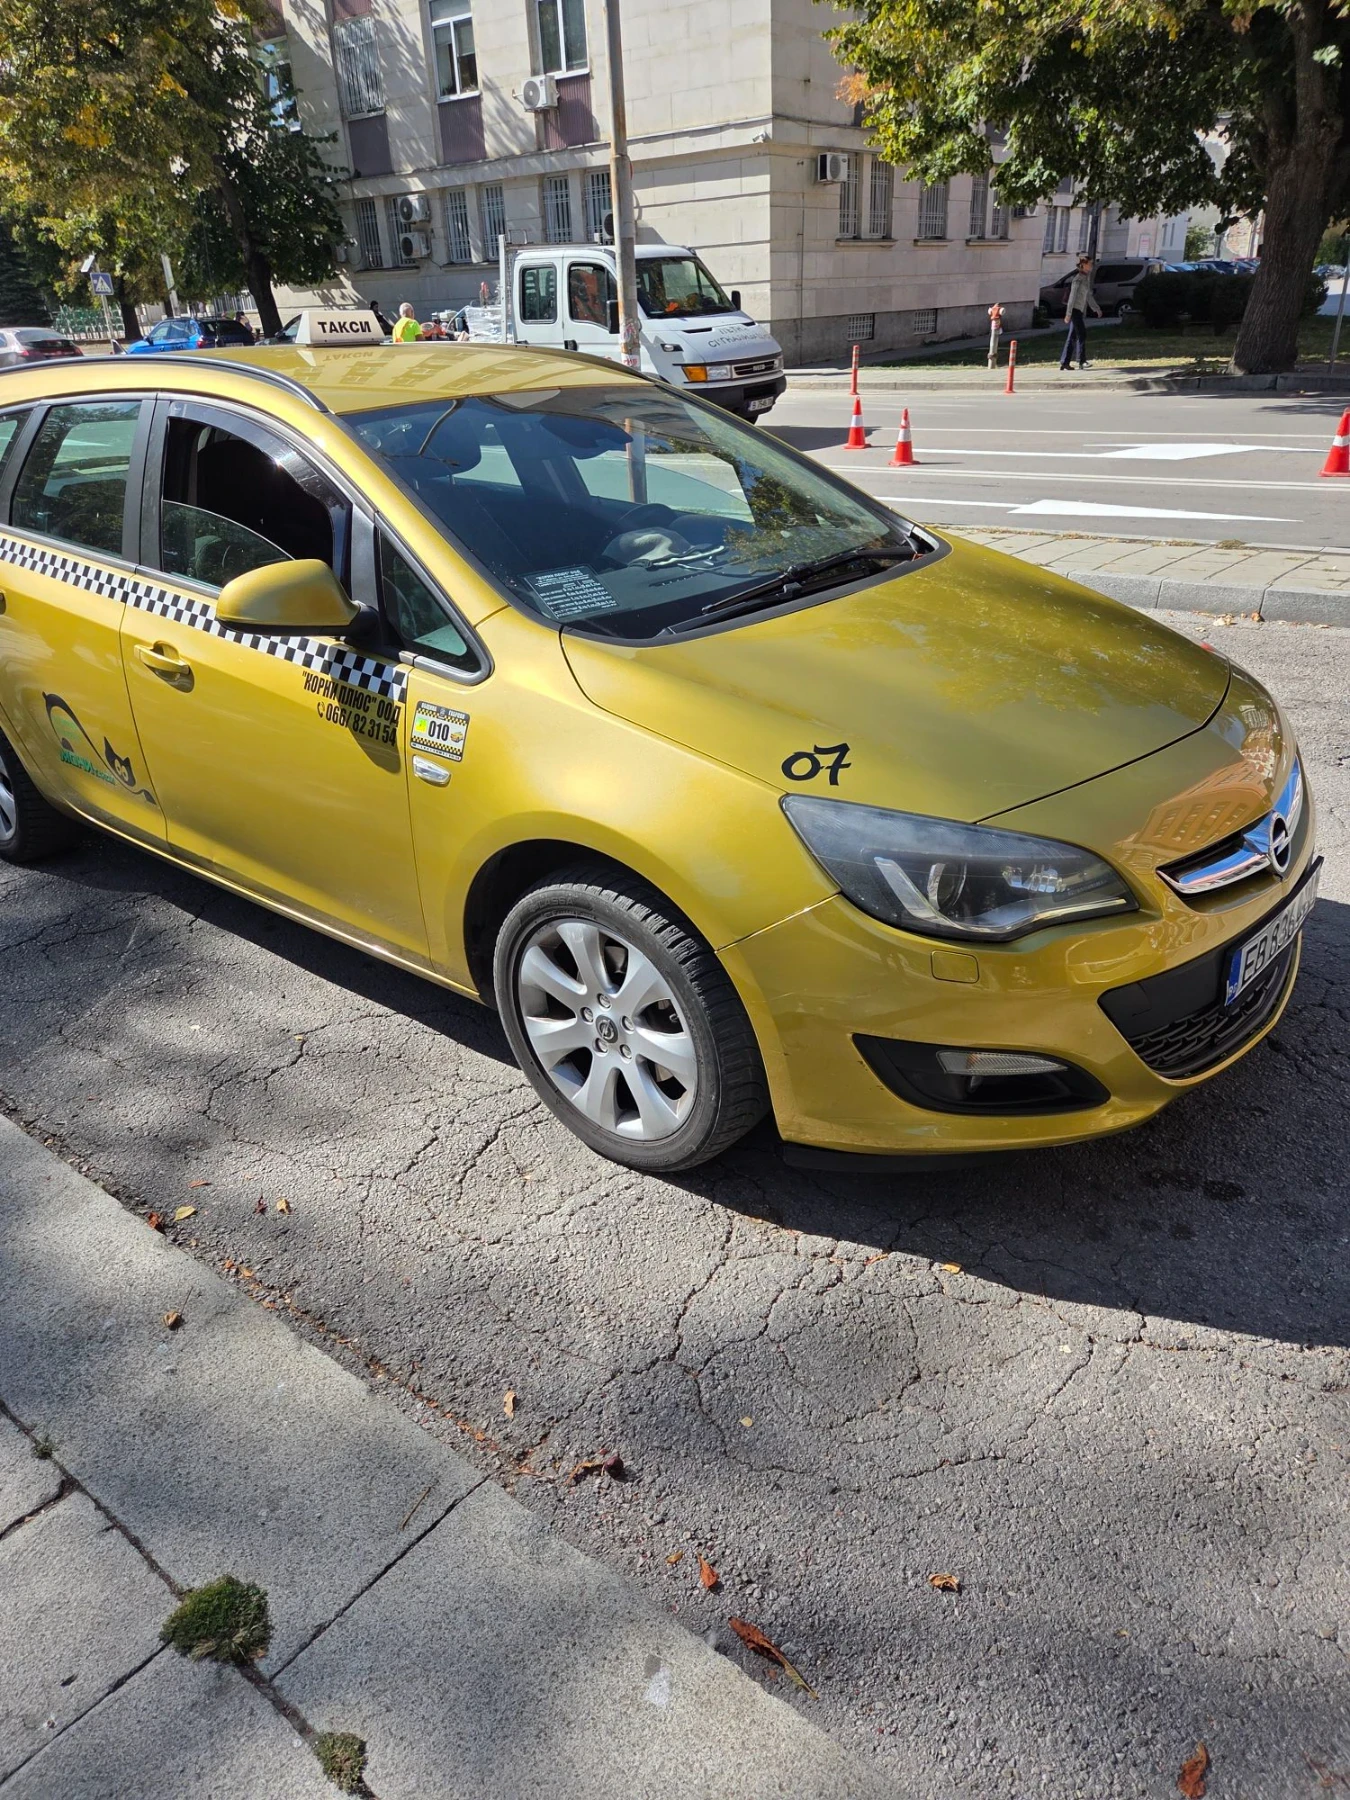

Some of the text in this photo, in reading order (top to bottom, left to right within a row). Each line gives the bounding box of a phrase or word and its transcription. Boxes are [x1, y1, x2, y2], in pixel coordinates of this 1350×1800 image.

[317, 321, 372, 334] ТАКСИ
[302, 671, 402, 728] "КОРНИ ПЛЮС" ООД
[428, 720, 450, 742] 010
[781, 742, 852, 786] 07
